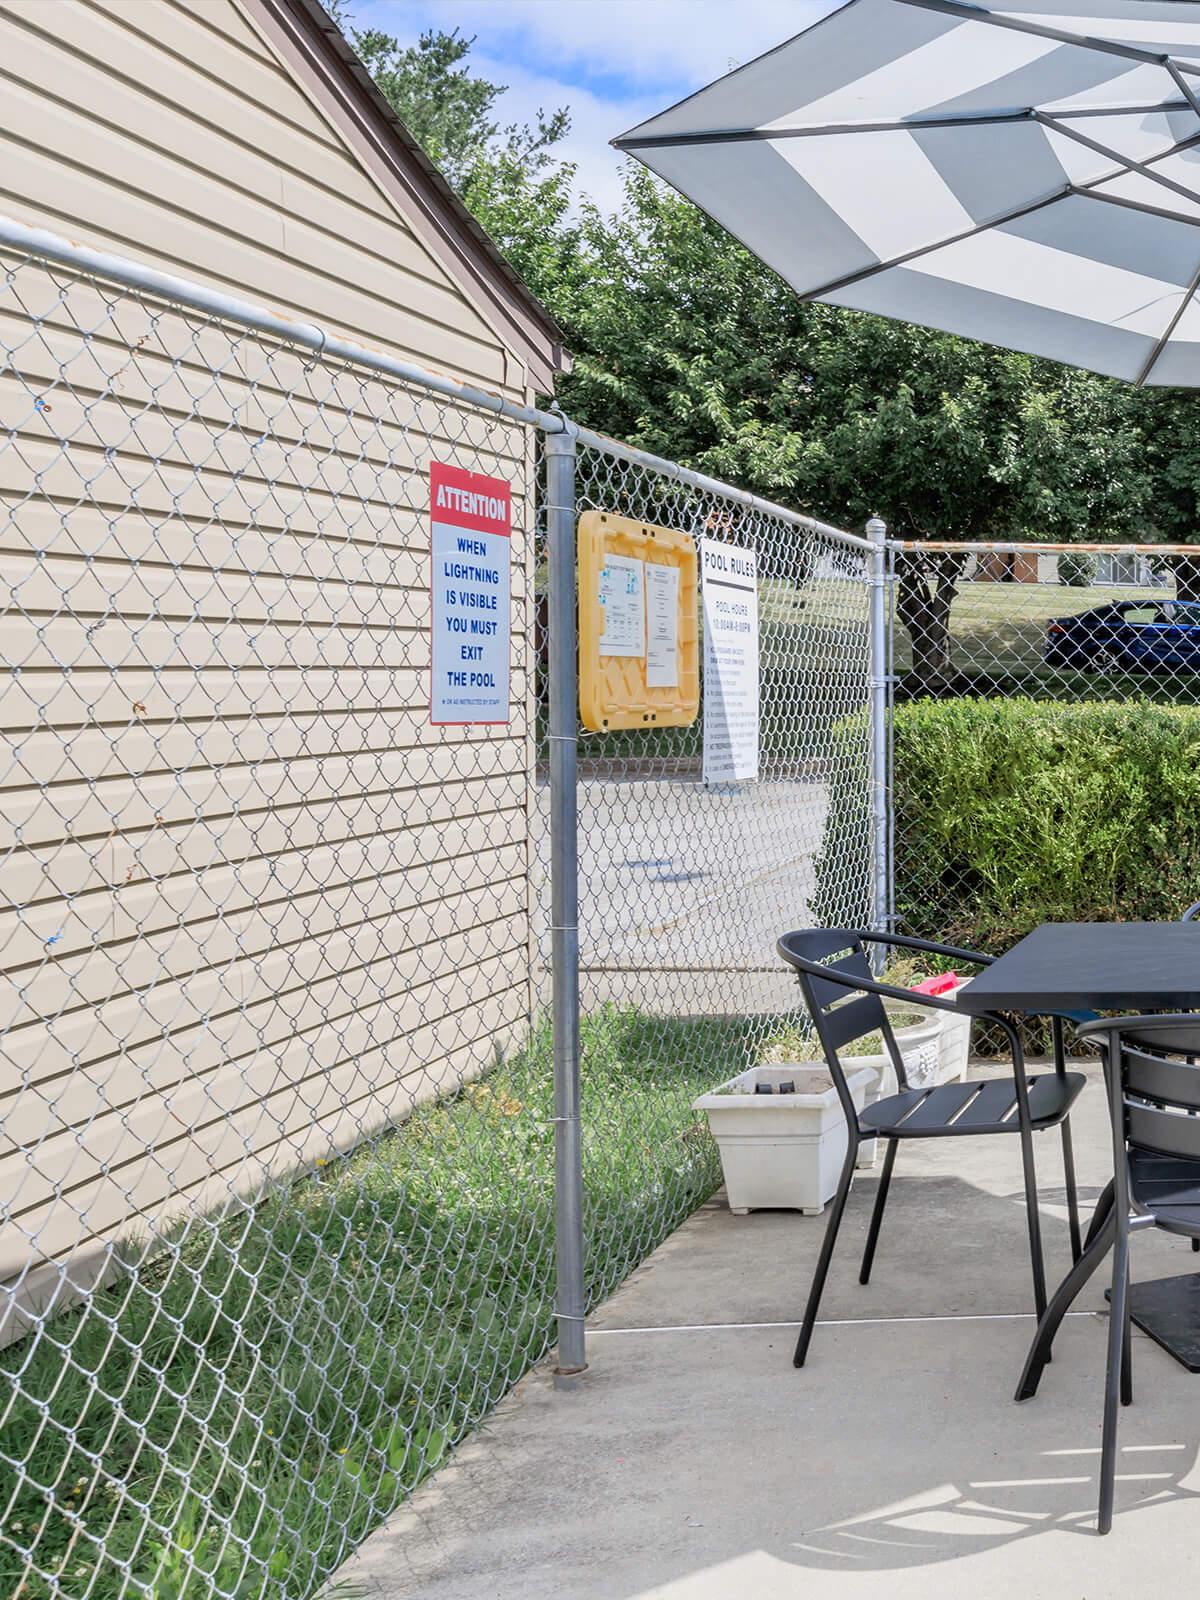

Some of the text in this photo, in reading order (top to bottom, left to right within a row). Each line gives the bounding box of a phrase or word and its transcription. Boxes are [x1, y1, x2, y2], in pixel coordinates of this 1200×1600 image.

[436, 484, 506, 522] ATTENTION
[457, 537, 487, 556] WHEN
[444, 562, 499, 584] LIGHTNING
[704, 551, 755, 578] POOL RULES
[446, 589, 497, 610] IS VISIBLE
[446, 617, 498, 636] YOU MUST
[461, 645, 484, 661] EXIT
[447, 671, 496, 688] THE POOL
